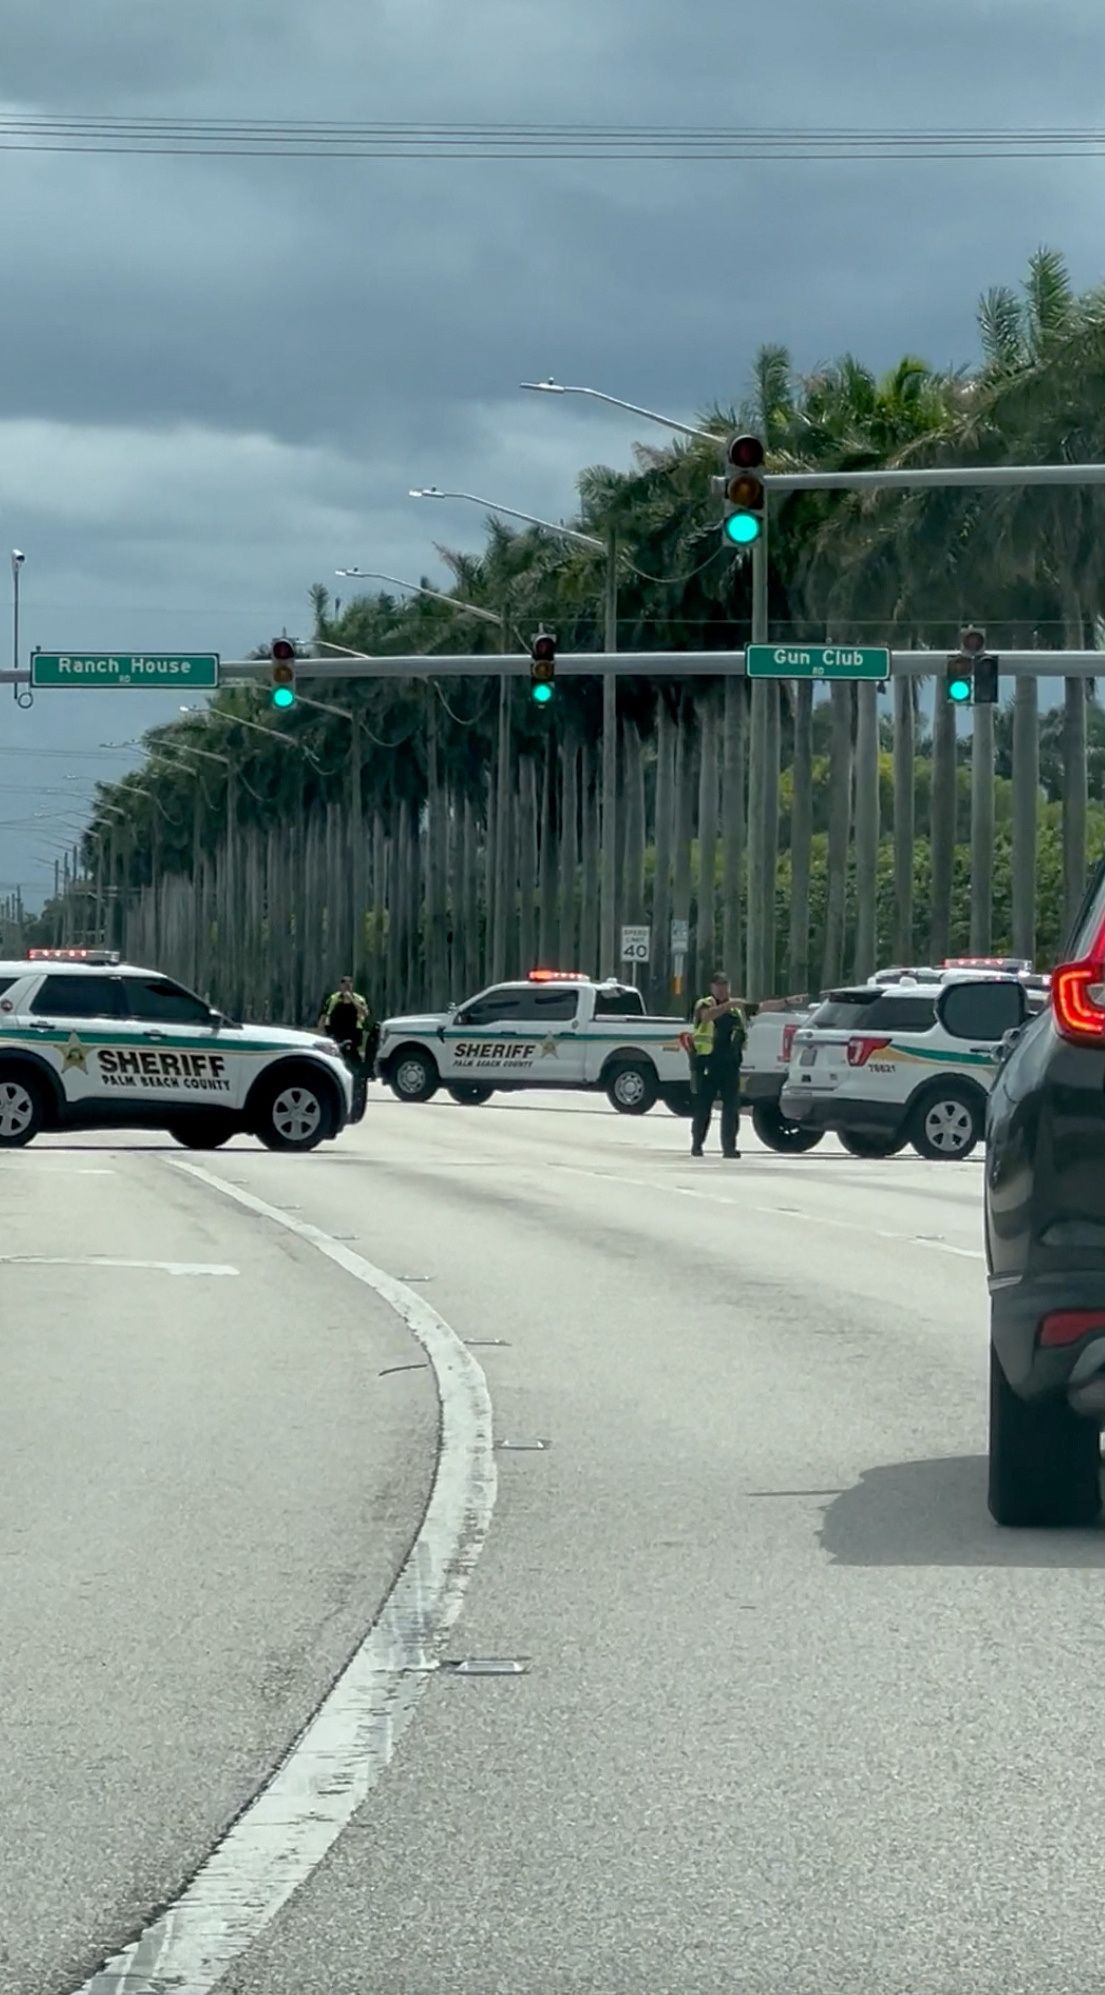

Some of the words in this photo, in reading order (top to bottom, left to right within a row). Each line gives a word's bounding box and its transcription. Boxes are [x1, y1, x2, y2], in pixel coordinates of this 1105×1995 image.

[58, 657, 119, 673] Ranch
[131, 657, 191, 673] House
[774, 649, 810, 665] Gun
[822, 649, 864, 666] Club
[119, 674, 131, 683] RD
[812, 667, 825, 676] RD
[624, 929, 648, 937] SPEED
[624, 944, 647, 958] 40
[454, 1043, 536, 1059] SHERIFF
[97, 1049, 225, 1078] SHERIFF
[453, 1060, 473, 1068] PALM
[476, 1060, 502, 1068] BEACH
[503, 1061, 534, 1069] COUNTY
[101, 1074, 137, 1087] PALM
[140, 1076, 180, 1089] BEACH
[183, 1078, 230, 1092] COUNTY
